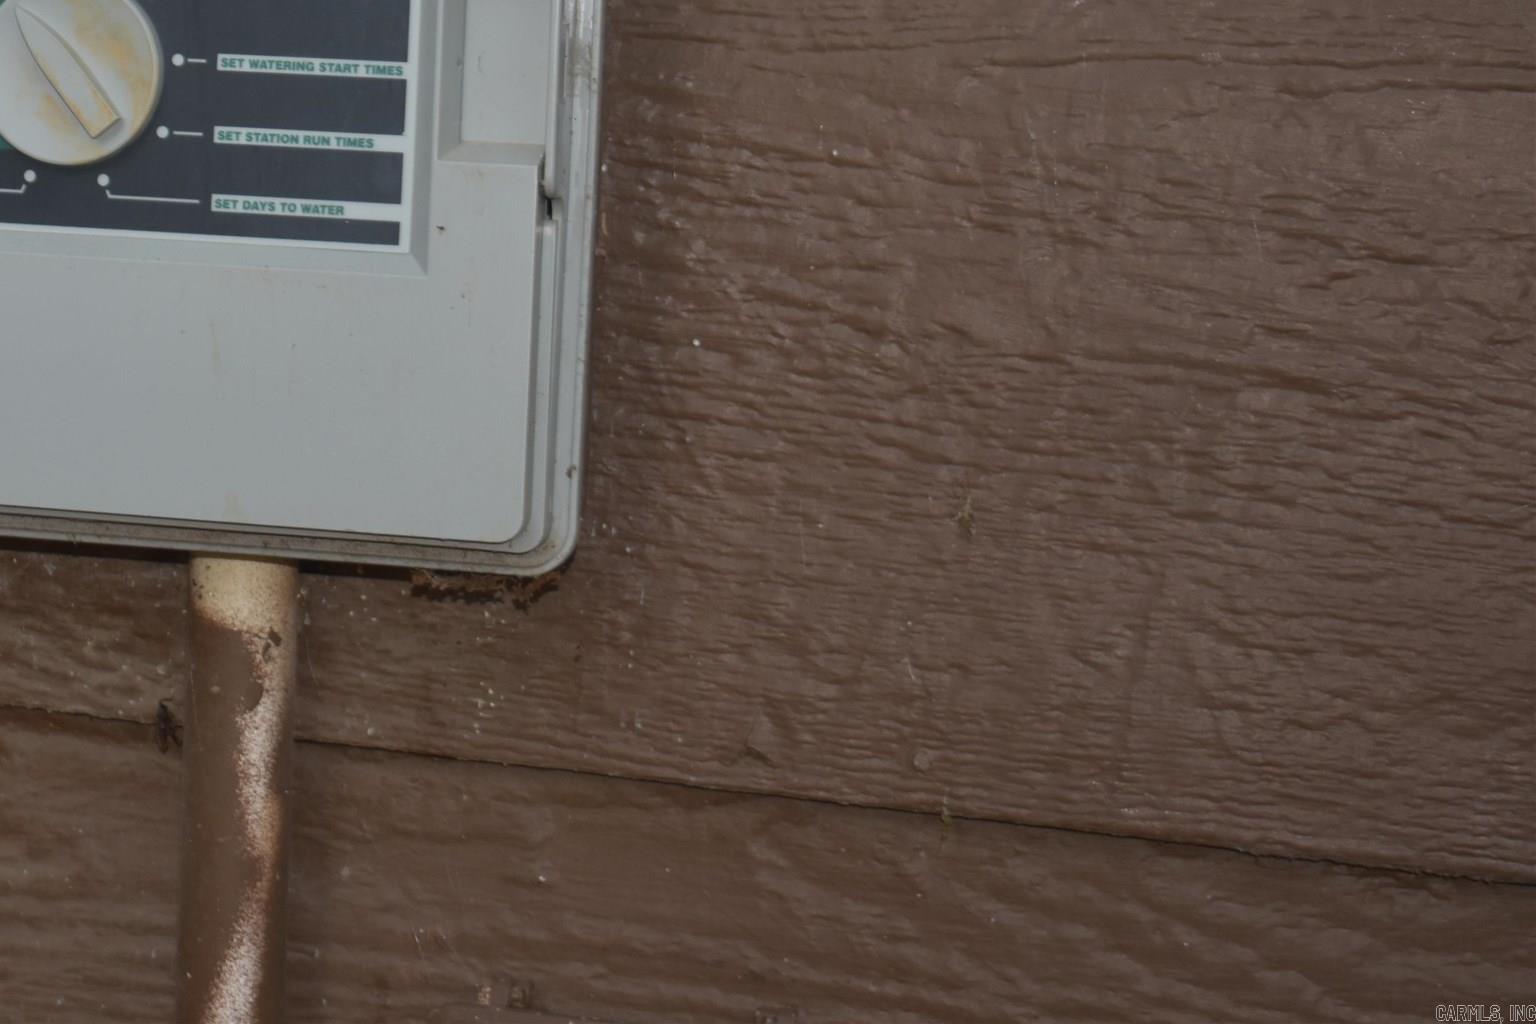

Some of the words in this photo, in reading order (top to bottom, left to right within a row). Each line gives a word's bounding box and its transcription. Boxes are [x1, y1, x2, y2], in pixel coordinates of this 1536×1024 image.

[221, 57, 245, 68] SET
[248, 58, 314, 72] WATERING
[319, 61, 360, 73] START
[364, 64, 404, 76] TIMES
[217, 130, 242, 141] SET
[245, 132, 299, 144] STATION
[303, 135, 331, 146] RUN
[334, 137, 375, 148] TIMES
[214, 198, 238, 209] SET
[242, 200, 276, 212] DAYS
[280, 201, 297, 212] TO
[300, 203, 345, 216] WATER
